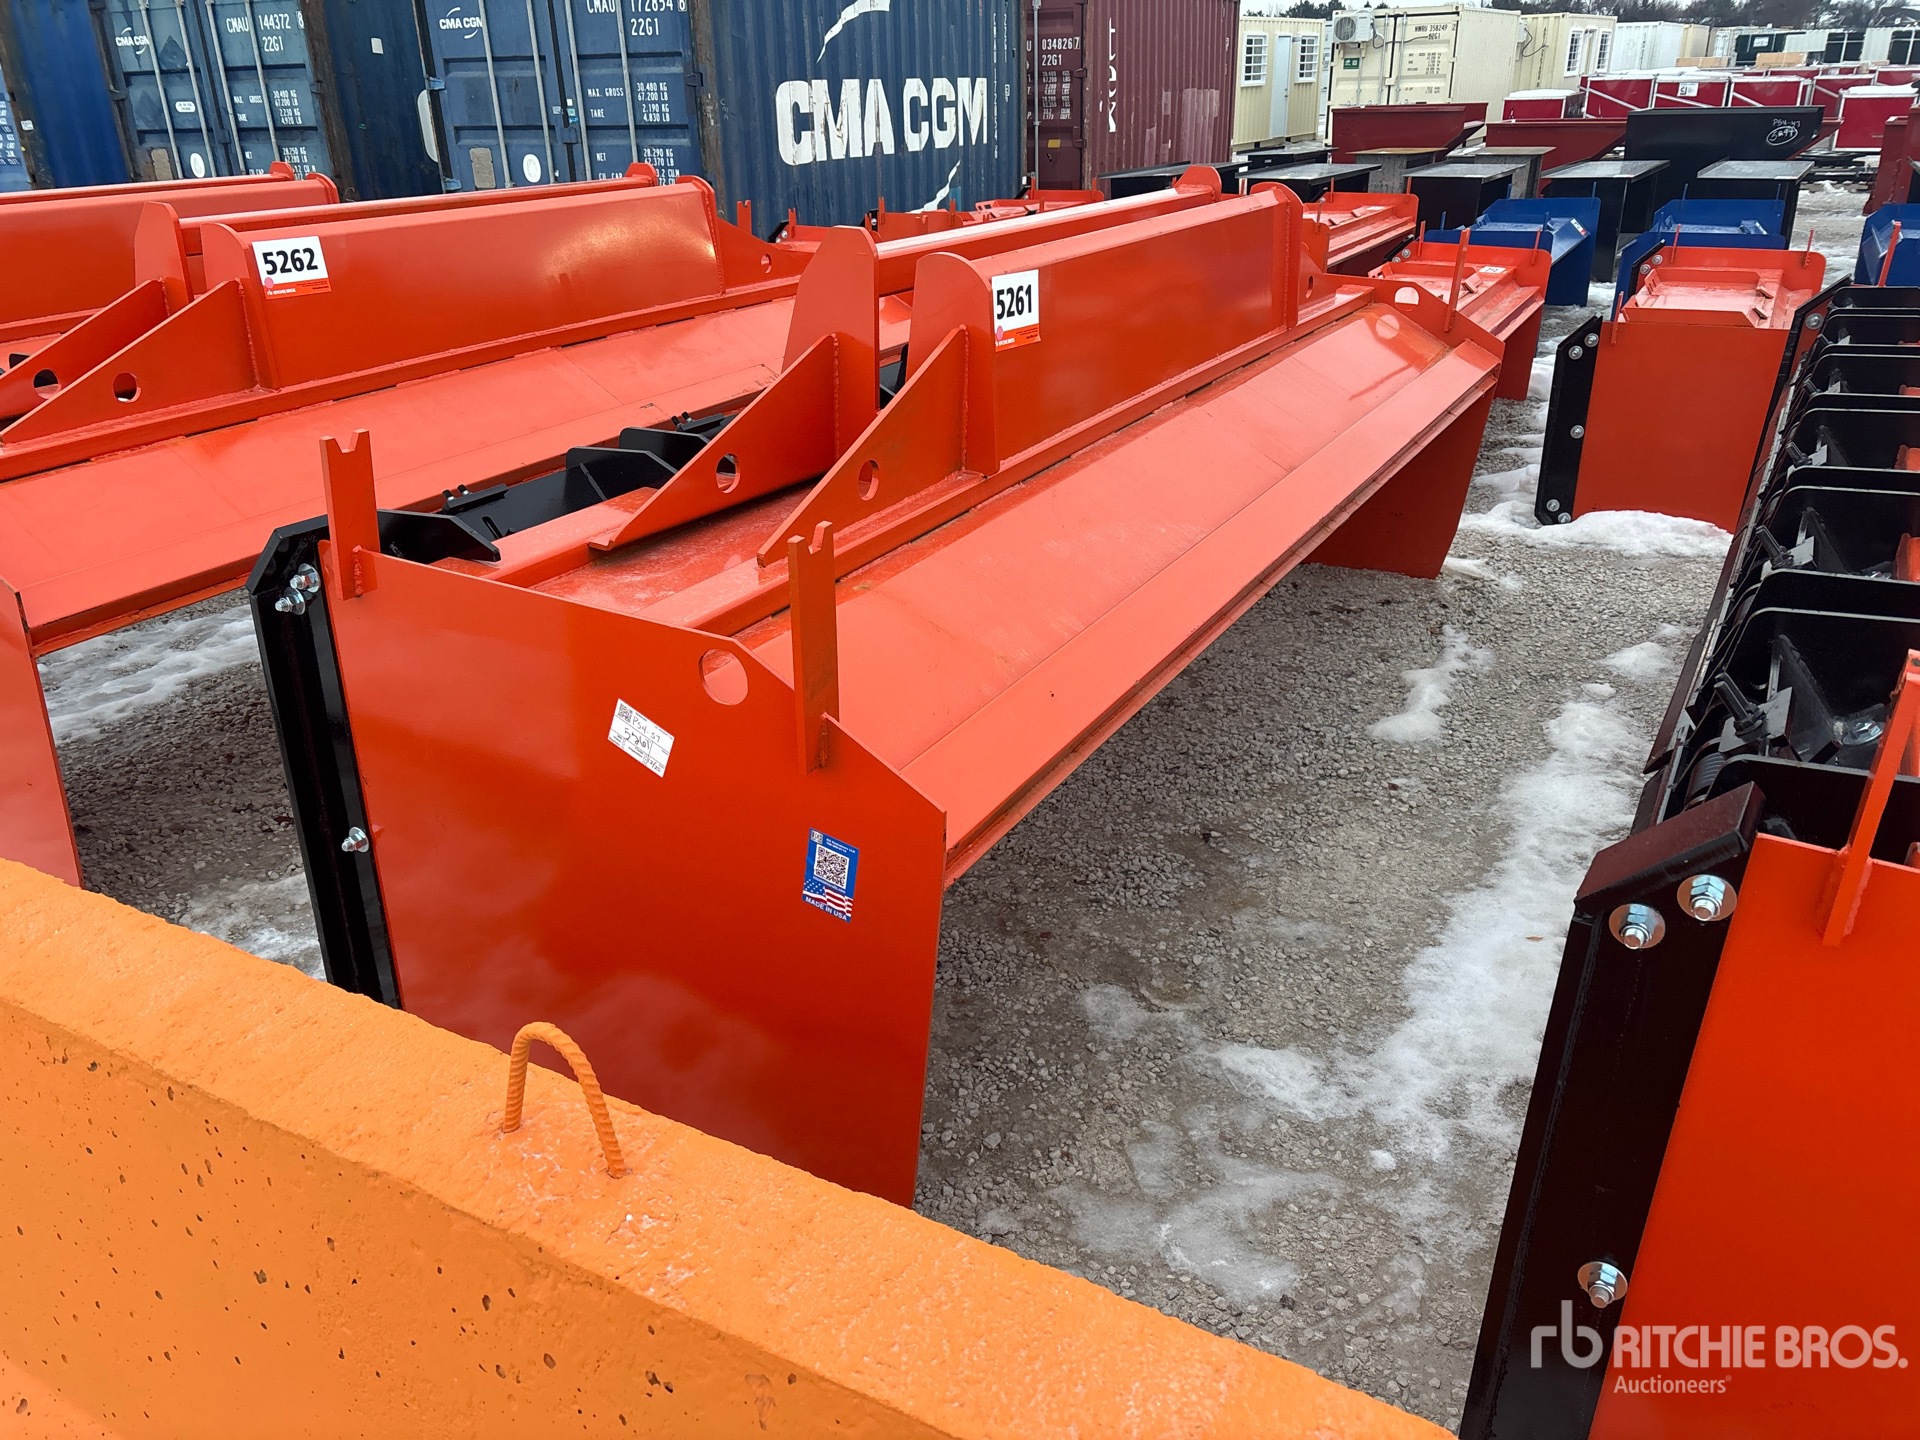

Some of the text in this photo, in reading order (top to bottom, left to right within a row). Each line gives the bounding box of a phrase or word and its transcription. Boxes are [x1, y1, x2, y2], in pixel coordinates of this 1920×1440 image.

[226, 17, 249, 33] CMAU
[259, 13, 291, 30] 144372
[439, 18, 462, 29] CMA
[631, 18, 659, 35] 22G1
[115, 36, 134, 46] CMA
[262, 36, 283, 52] 22G1
[1042, 38, 1072, 50] 034826
[1042, 54, 1062, 66] 22G1
[637, 82, 667, 91] 30.480 KG
[587, 88, 624, 97] MAX. GROSS
[638, 92, 668, 101] 67.200 LB
[642, 104, 669, 112] 2.190 KG
[590, 109, 605, 118] TARE
[662, 113, 670, 122] LB
[776, 77, 988, 165] CMA CGM
[596, 153, 606, 161] NET
[666, 149, 673, 157] KG
[667, 158, 674, 166] LB
[262, 247, 318, 275] 5262
[996, 284, 1032, 320] 5261
[805, 896, 848, 921] MADE IN USA
